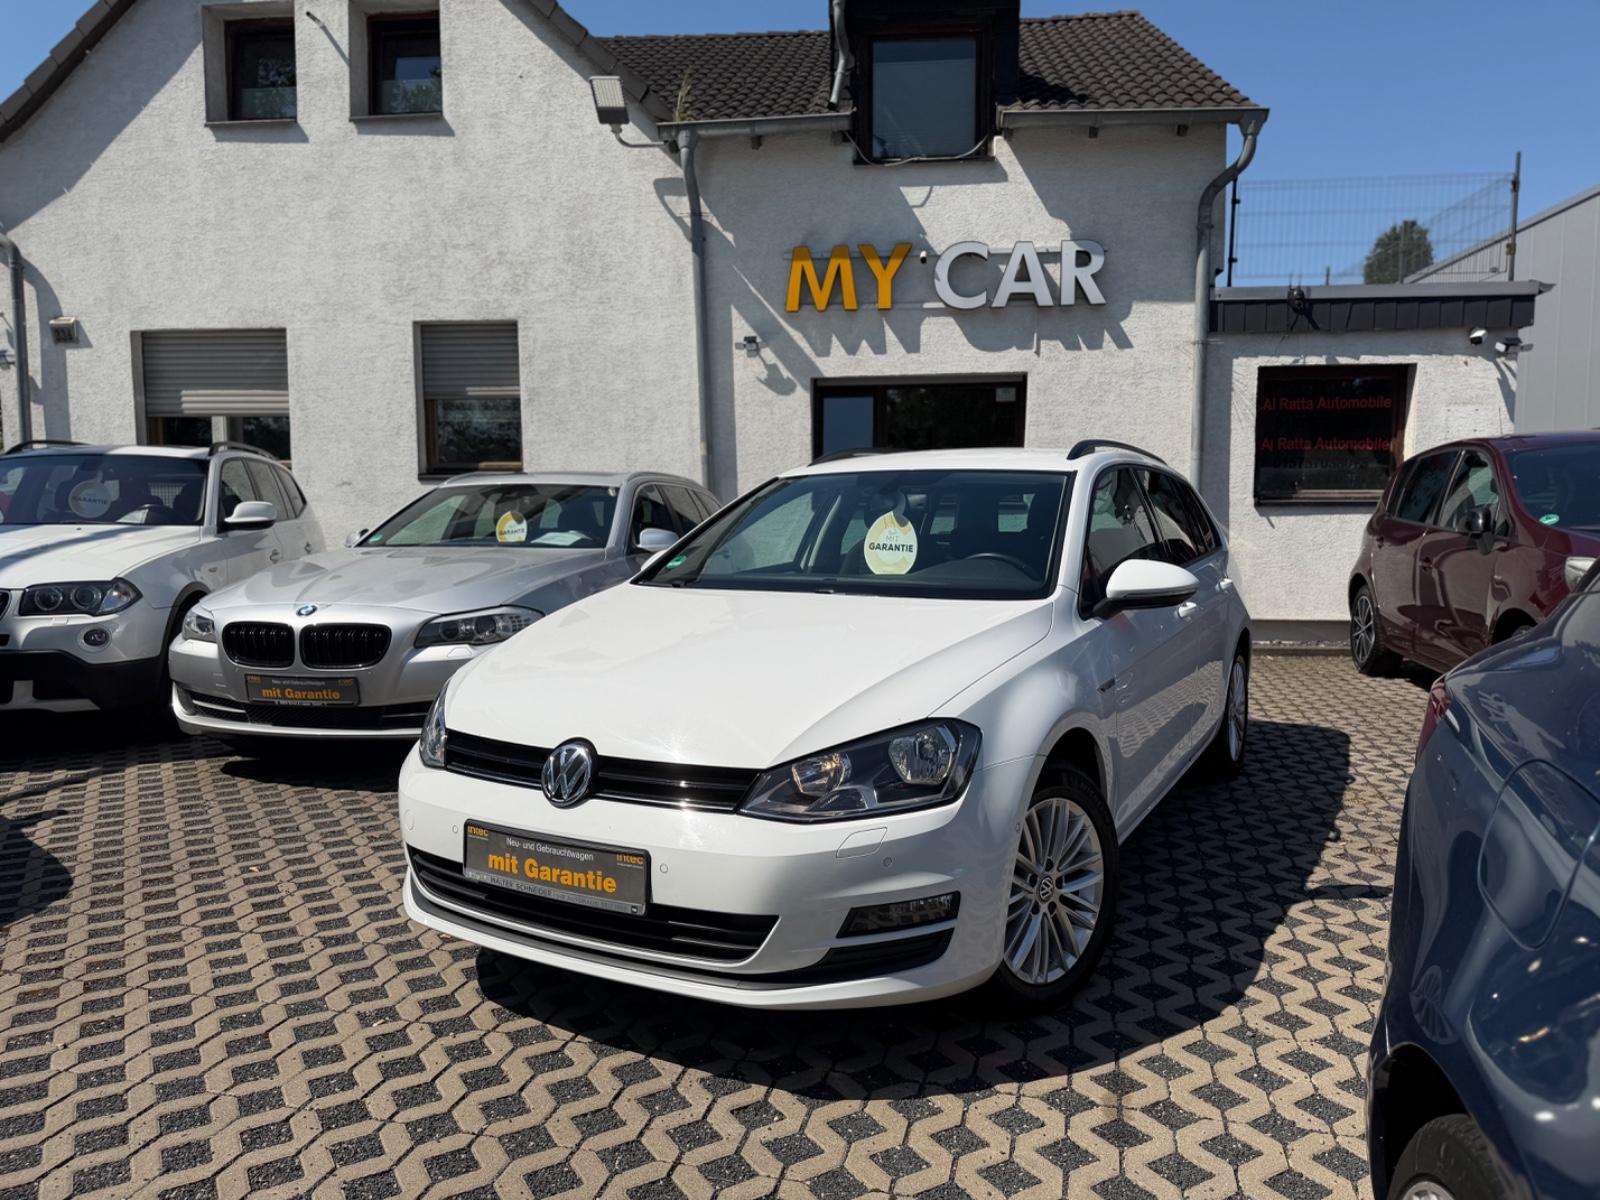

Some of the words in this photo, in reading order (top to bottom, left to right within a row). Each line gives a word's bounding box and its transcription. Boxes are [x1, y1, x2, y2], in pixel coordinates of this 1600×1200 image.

[785, 243, 912, 312] MY
[933, 240, 1106, 310] CAR
[1279, 398, 1313, 411] Ratta
[1316, 395, 1393, 410] Automobile
[1278, 437, 1312, 450] Ratta
[1316, 436, 1392, 451] Automobile
[868, 542, 914, 553] GARANTIE
[261, 687, 281, 698] mit
[284, 688, 341, 700] Garantie
[506, 837, 522, 848] Neu-
[522, 841, 535, 851] und
[536, 842, 594, 862] Gebrauchtwagen
[487, 852, 519, 875] mit
[524, 858, 617, 893] Garantie
